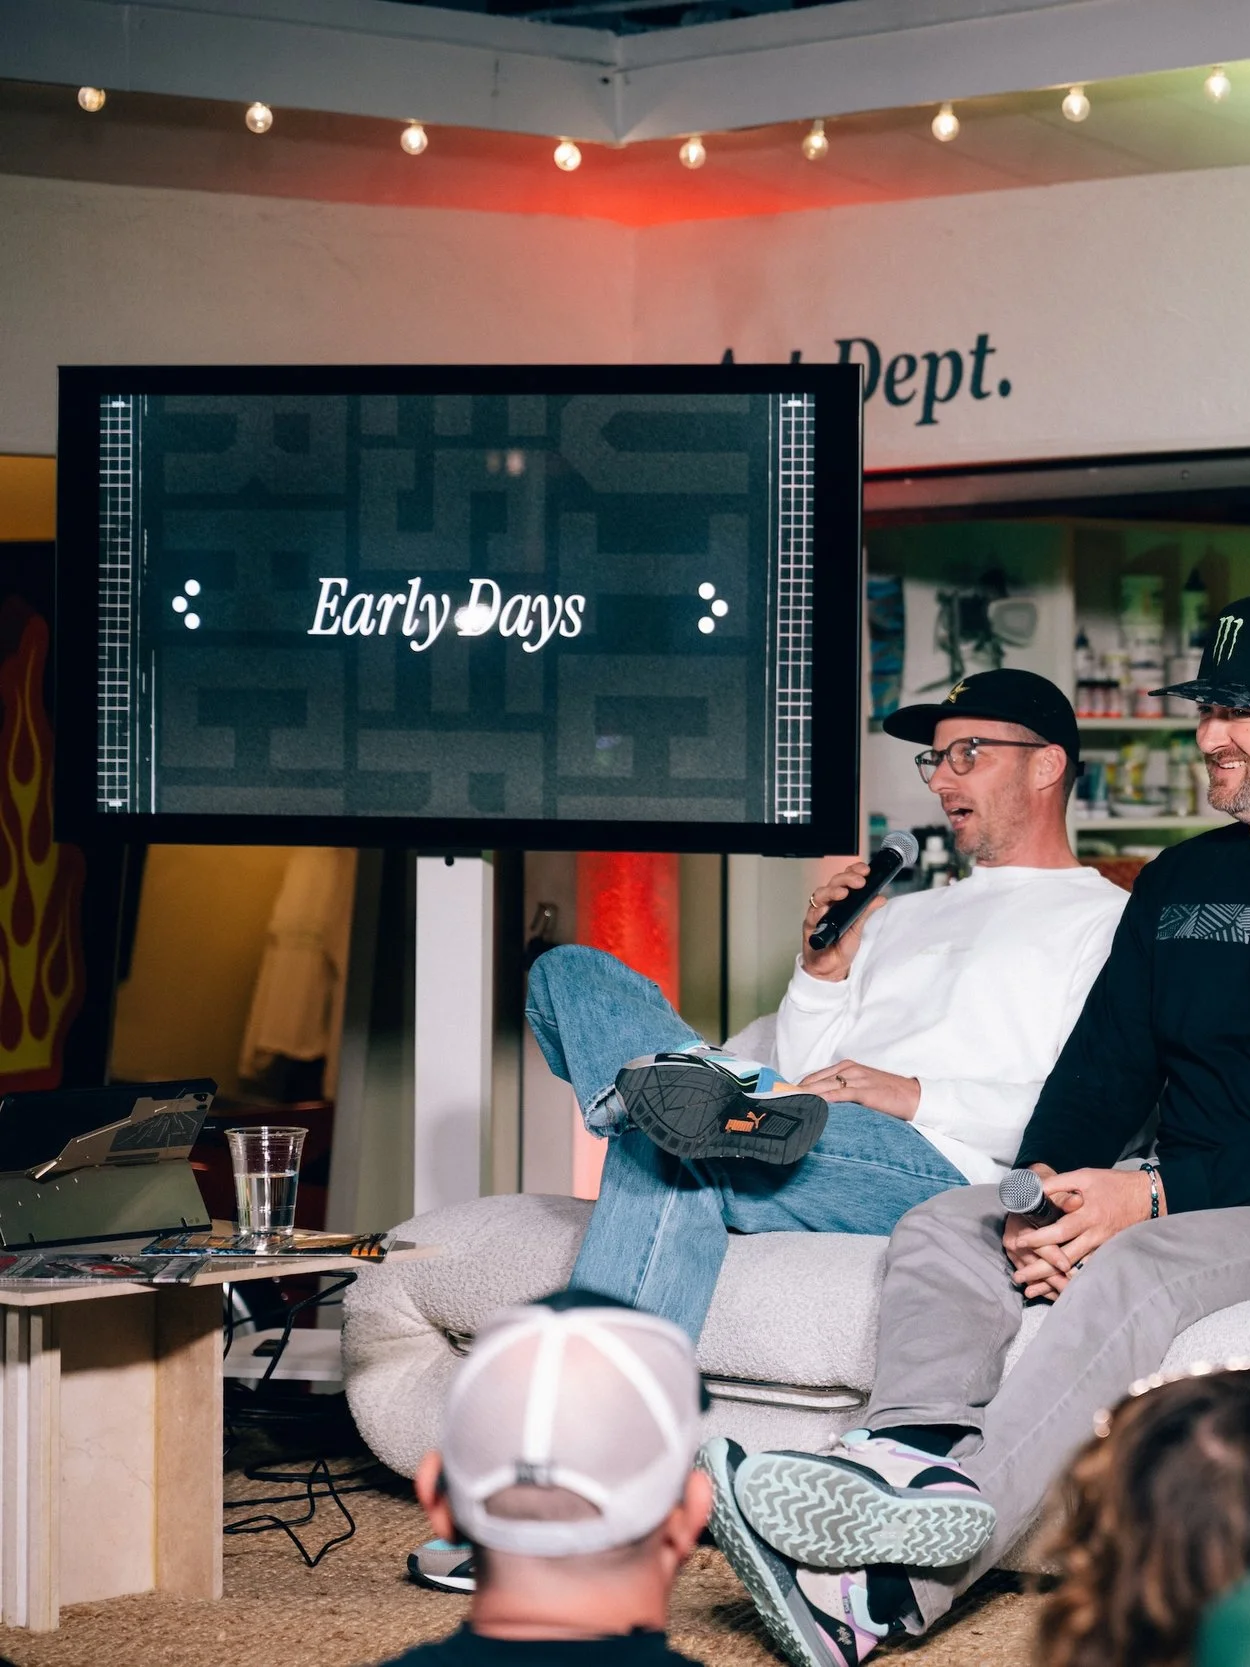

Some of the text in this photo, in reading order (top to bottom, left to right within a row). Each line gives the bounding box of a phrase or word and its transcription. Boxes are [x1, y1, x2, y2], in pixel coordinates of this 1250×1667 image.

[834, 333, 1012, 426] Dept.
[307, 577, 586, 653] Early Days
